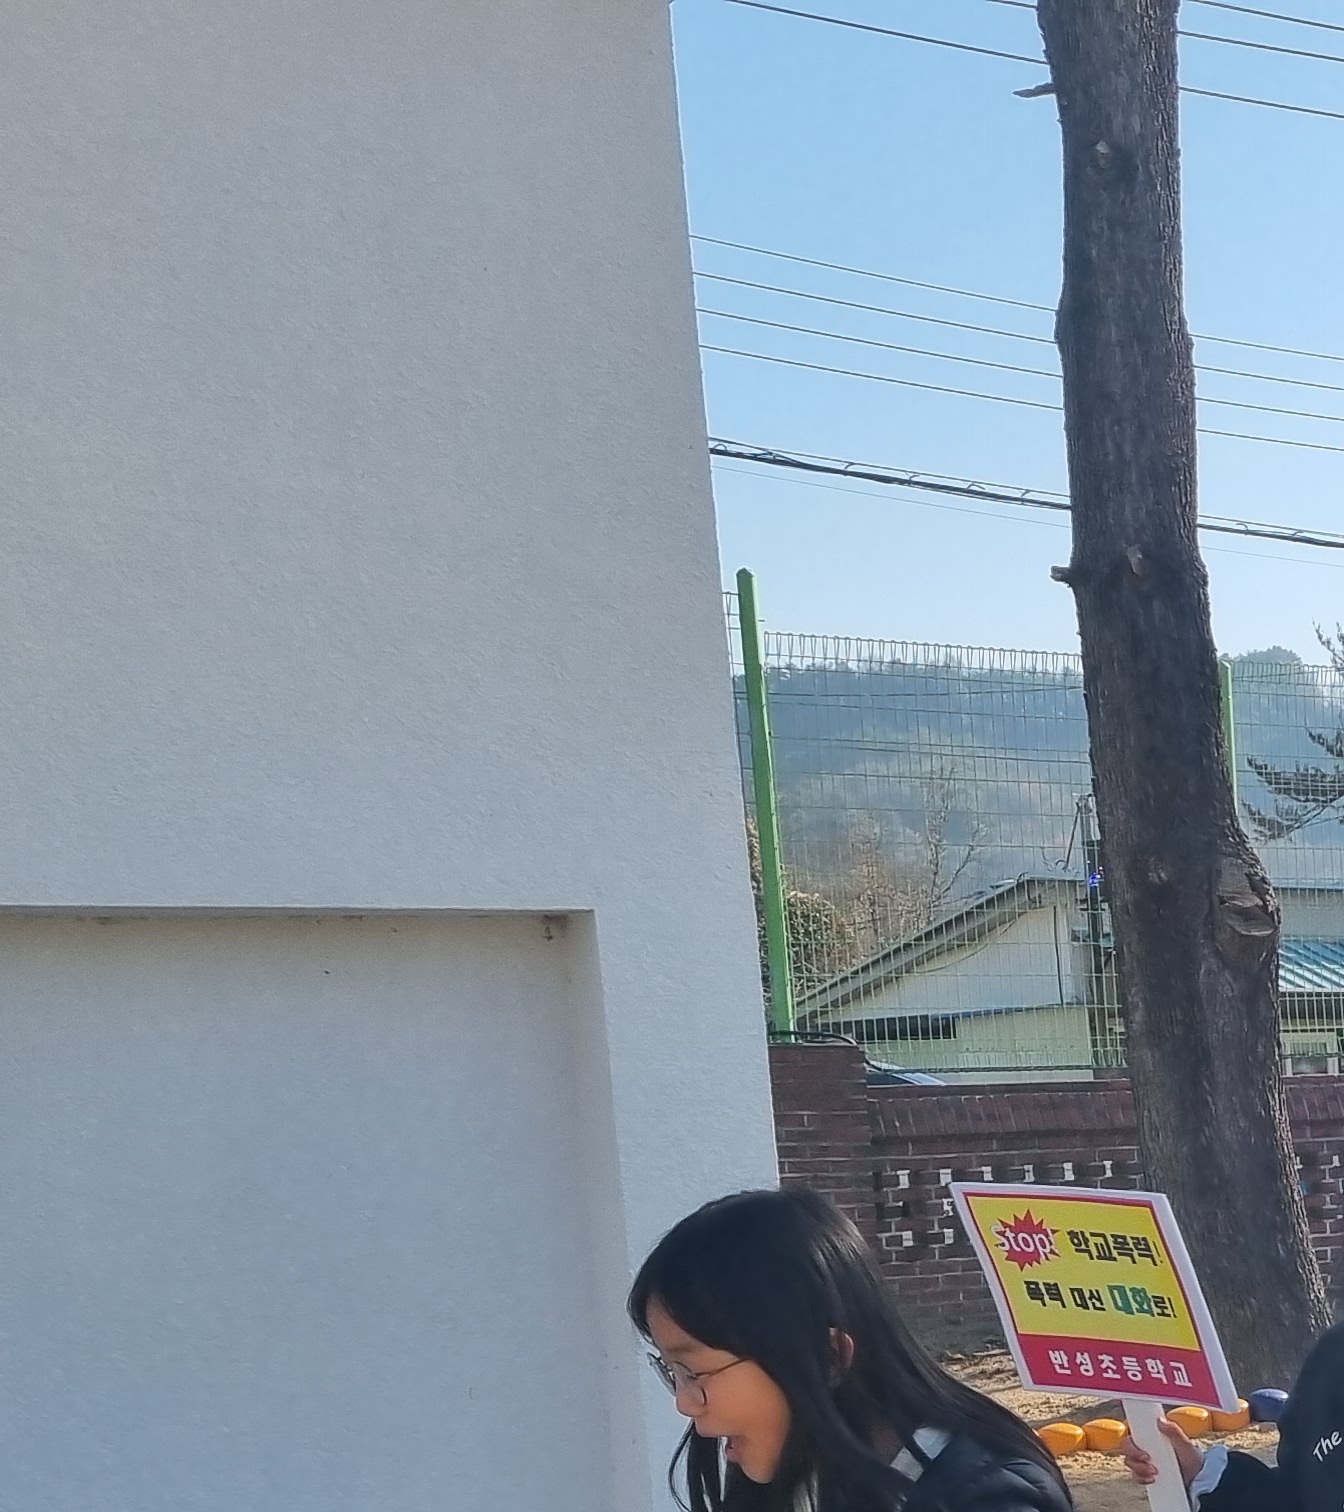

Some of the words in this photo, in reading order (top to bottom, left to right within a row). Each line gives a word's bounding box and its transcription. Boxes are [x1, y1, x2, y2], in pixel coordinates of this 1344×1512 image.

[989, 1222, 1059, 1259] Stop!
[1066, 1228, 1164, 1267] 학교폭력!
[1024, 1279, 1066, 1309] 폭력
[1069, 1286, 1106, 1312] 대신
[1107, 1283, 1178, 1319] 대화로!
[1048, 1348, 1193, 1389] 반성초등학교
[1311, 1430, 1343, 1463] The
